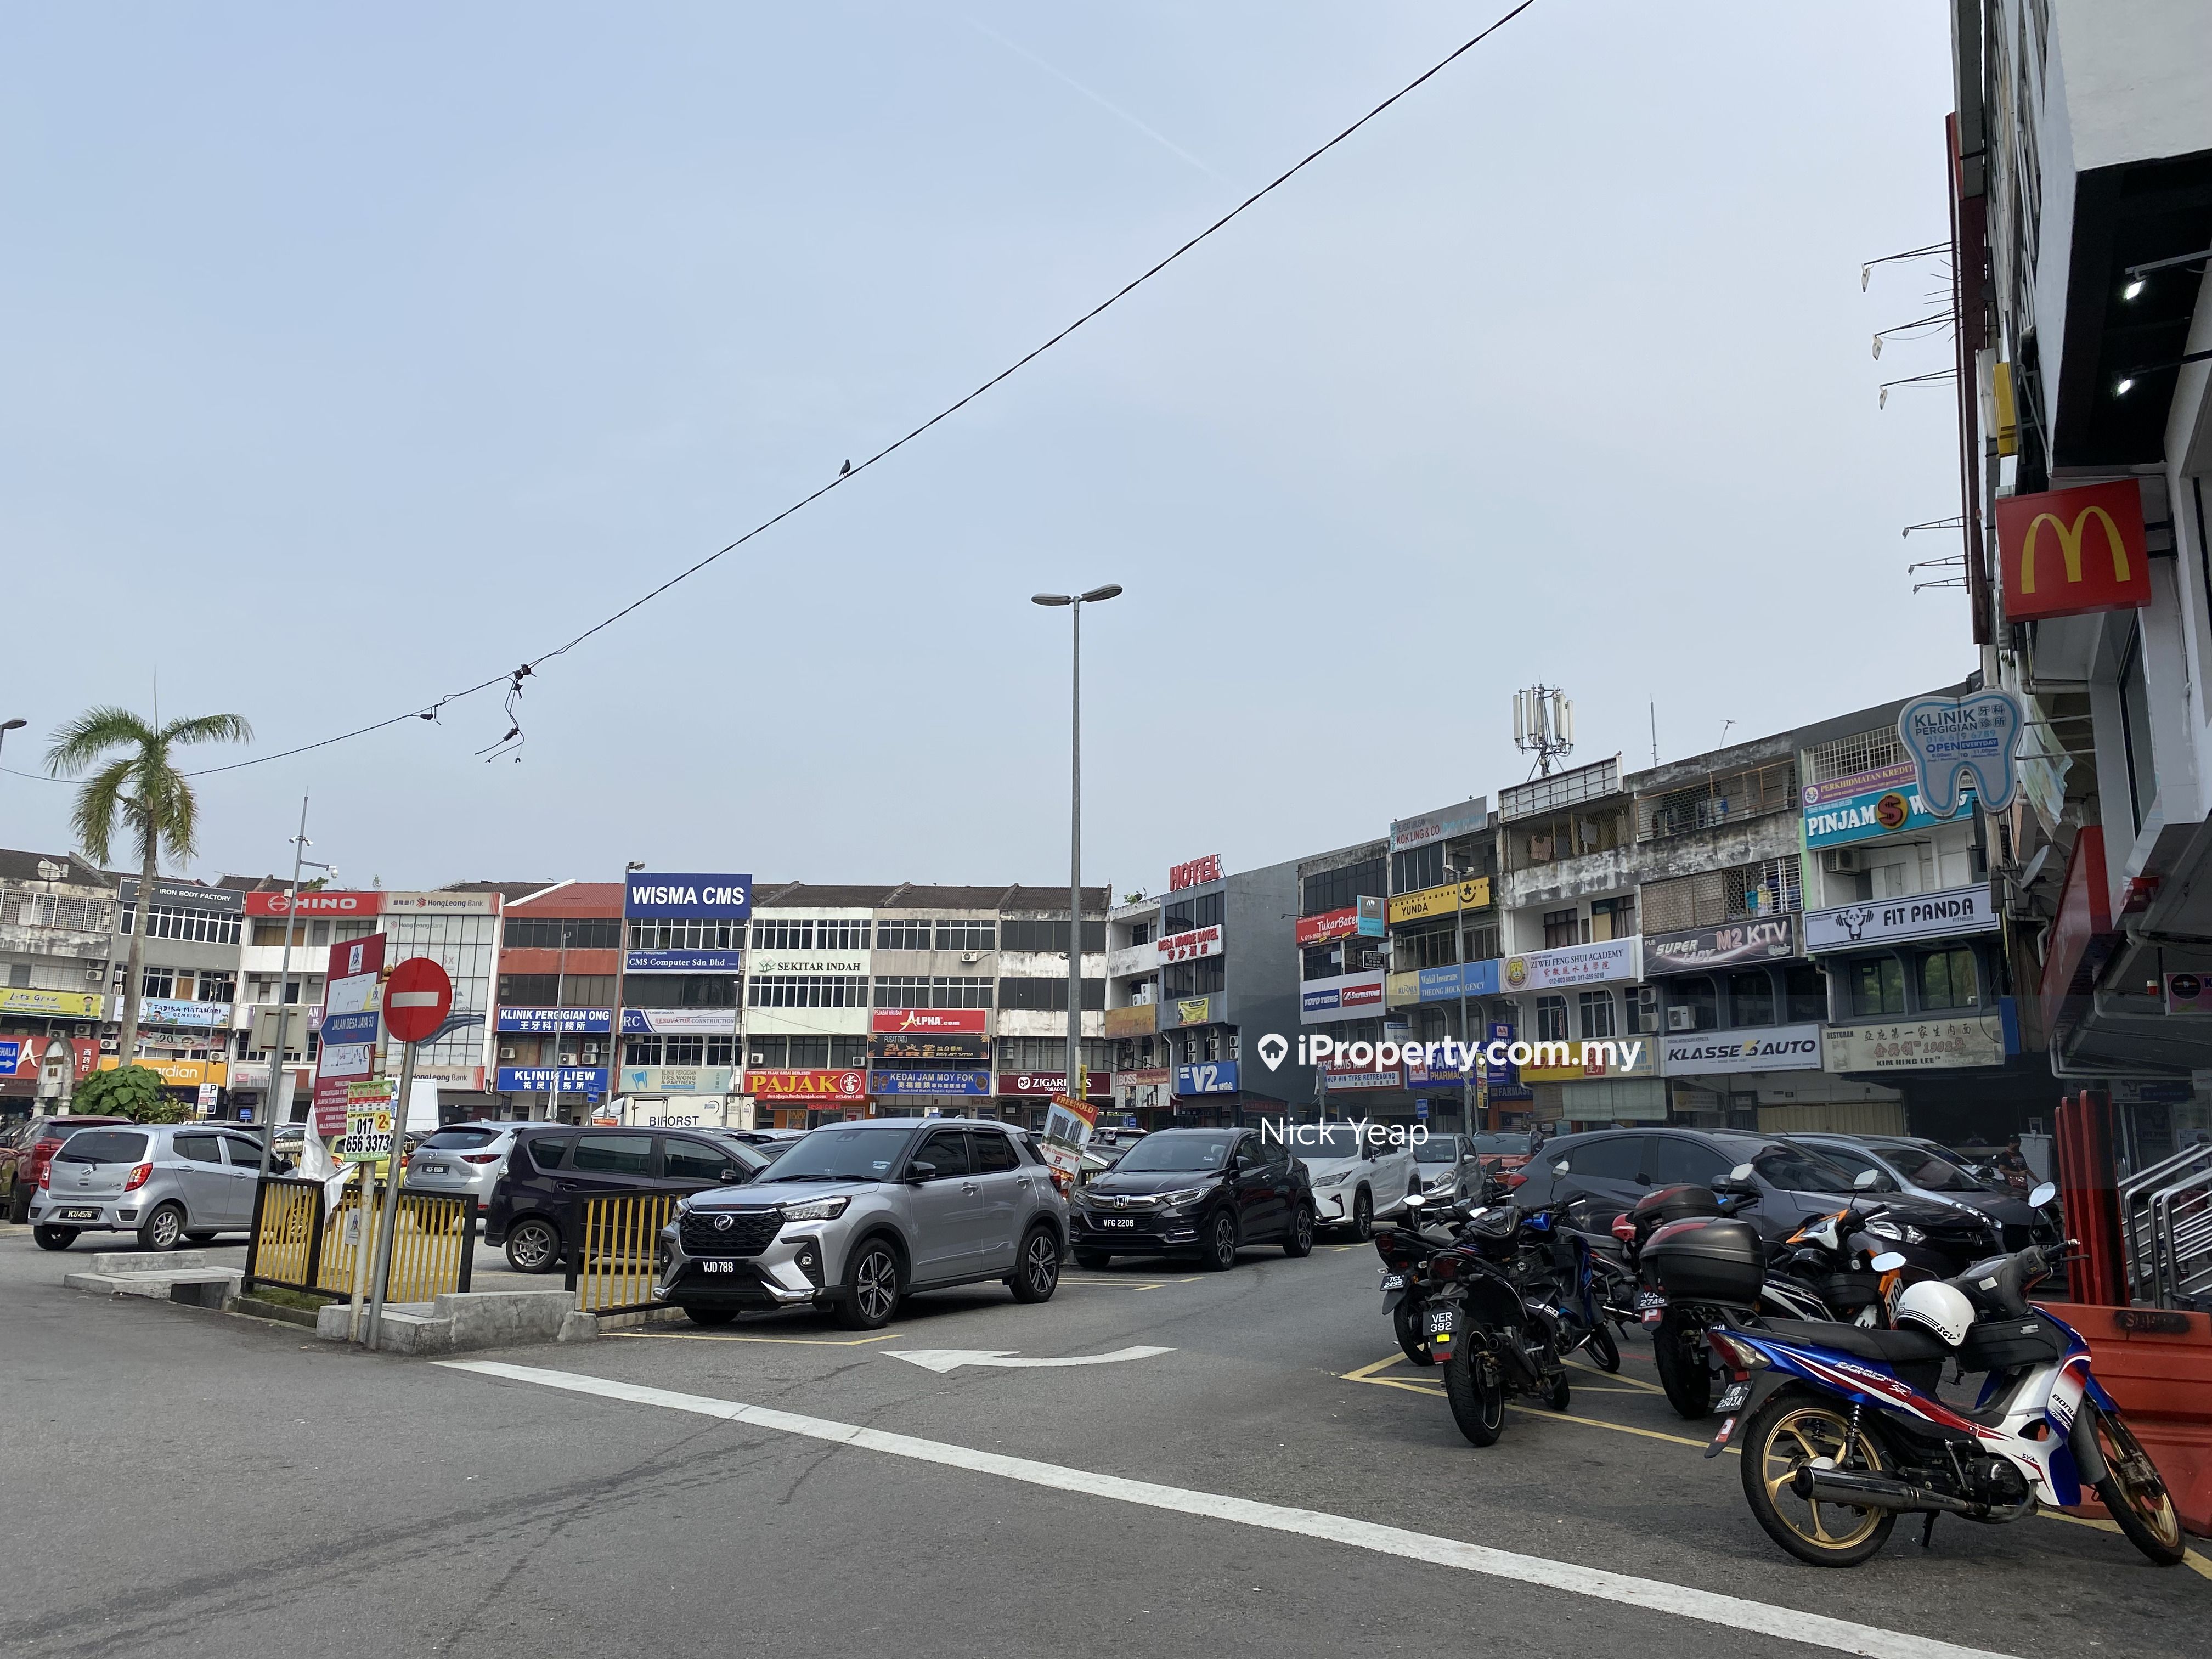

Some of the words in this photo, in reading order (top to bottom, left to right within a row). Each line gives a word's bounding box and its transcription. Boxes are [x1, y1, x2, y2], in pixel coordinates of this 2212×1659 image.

[1978, 703, 2005, 715] 牙科
[1915, 709, 1976, 727] KLINIK
[1916, 723, 1977, 736] PERGIGIAN
[1926, 742, 1960, 753] OPEN
[1962, 740, 1997, 748] EVERYDAY
[1820, 772, 1882, 792] PERKHIDMATAN
[1883, 765, 1913, 777] KREDIT
[1807, 804, 1876, 837] PINJAM
[1397, 833, 1409, 845] KOK
[1410, 828, 1424, 842] LING
[1425, 828, 1430, 837] &
[1170, 854, 1221, 891] HOTEL
[200, 893, 231, 901] FACTORY
[632, 887, 698, 904] WISMA
[702, 887, 744, 905] CMS
[295, 898, 357, 909] HINO
[428, 899, 466, 907] HongLeong
[1402, 903, 1429, 916] YUNDA
[1883, 908, 1905, 927] FIT
[1911, 898, 1974, 922] PANDA
[1158, 938, 1174, 951] DESA
[1175, 933, 1197, 947] HOUSE
[1197, 928, 1218, 942] HOTEL
[1655, 939, 1699, 957] SUPER
[1716, 928, 1742, 951] M2
[1747, 920, 1787, 945] KTV
[1553, 957, 1570, 966] FENG
[1571, 955, 1587, 963] SHUI
[1589, 949, 1623, 961] ACADEMY
[1683, 948, 1716, 963] LADY
[650, 958, 690, 967] Computer
[778, 962, 823, 970] SEKITAR
[1421, 974, 1436, 984] Wakil
[1436, 973, 1458, 983] Insurans
[1421, 987, 1444, 997] THEONG
[1444, 985, 1460, 994] HOCK
[1465, 981, 1485, 991] GENCY
[1304, 997, 1320, 1006] TOYO
[1321, 994, 1339, 1004] TIRES
[501, 1010, 533, 1019] KLINIK
[535, 1011, 586, 1020] PERGIGIAN
[589, 1011, 609, 1020] ONG
[623, 1016, 640, 1026] RC
[332, 1019, 346, 1031] JALAN
[346, 1018, 357, 1029] DESA
[358, 1017, 368, 1029] JAYA
[369, 1015, 374, 1028] 53
[1826, 1031, 1854, 1039] RESTORAN
[1668, 1045, 1742, 1061] KLASSE
[1760, 1040, 1816, 1055] AUTO
[564, 1071, 595, 1081] LIEW
[890, 1073, 915, 1081] KEDAI
[917, 1073, 934, 1081] JAM
[1191, 1065, 1218, 1092] V2
[210, 1085, 217, 1094] P
[749, 1075, 839, 1093] PAJAK
[1056, 1095, 1094, 1114] FREEHOLD
[357, 1118, 373, 1135] 017
[346, 1135, 363, 1152] 656
[365, 1135, 390, 1152] 3373
[703, 1262, 718, 1272] VJD
[719, 1262, 733, 1272] 788
[1432, 1312, 1453, 1323] VER
[1645, 1309, 1657, 1321] P
[1430, 1322, 1452, 1332] 392
[1835, 1361, 1888, 1382] BONUS
[1716, 1396, 1742, 1408] 2503A
[1715, 1419, 1733, 1441] P
[2021, 1453, 2039, 1464] SYM
